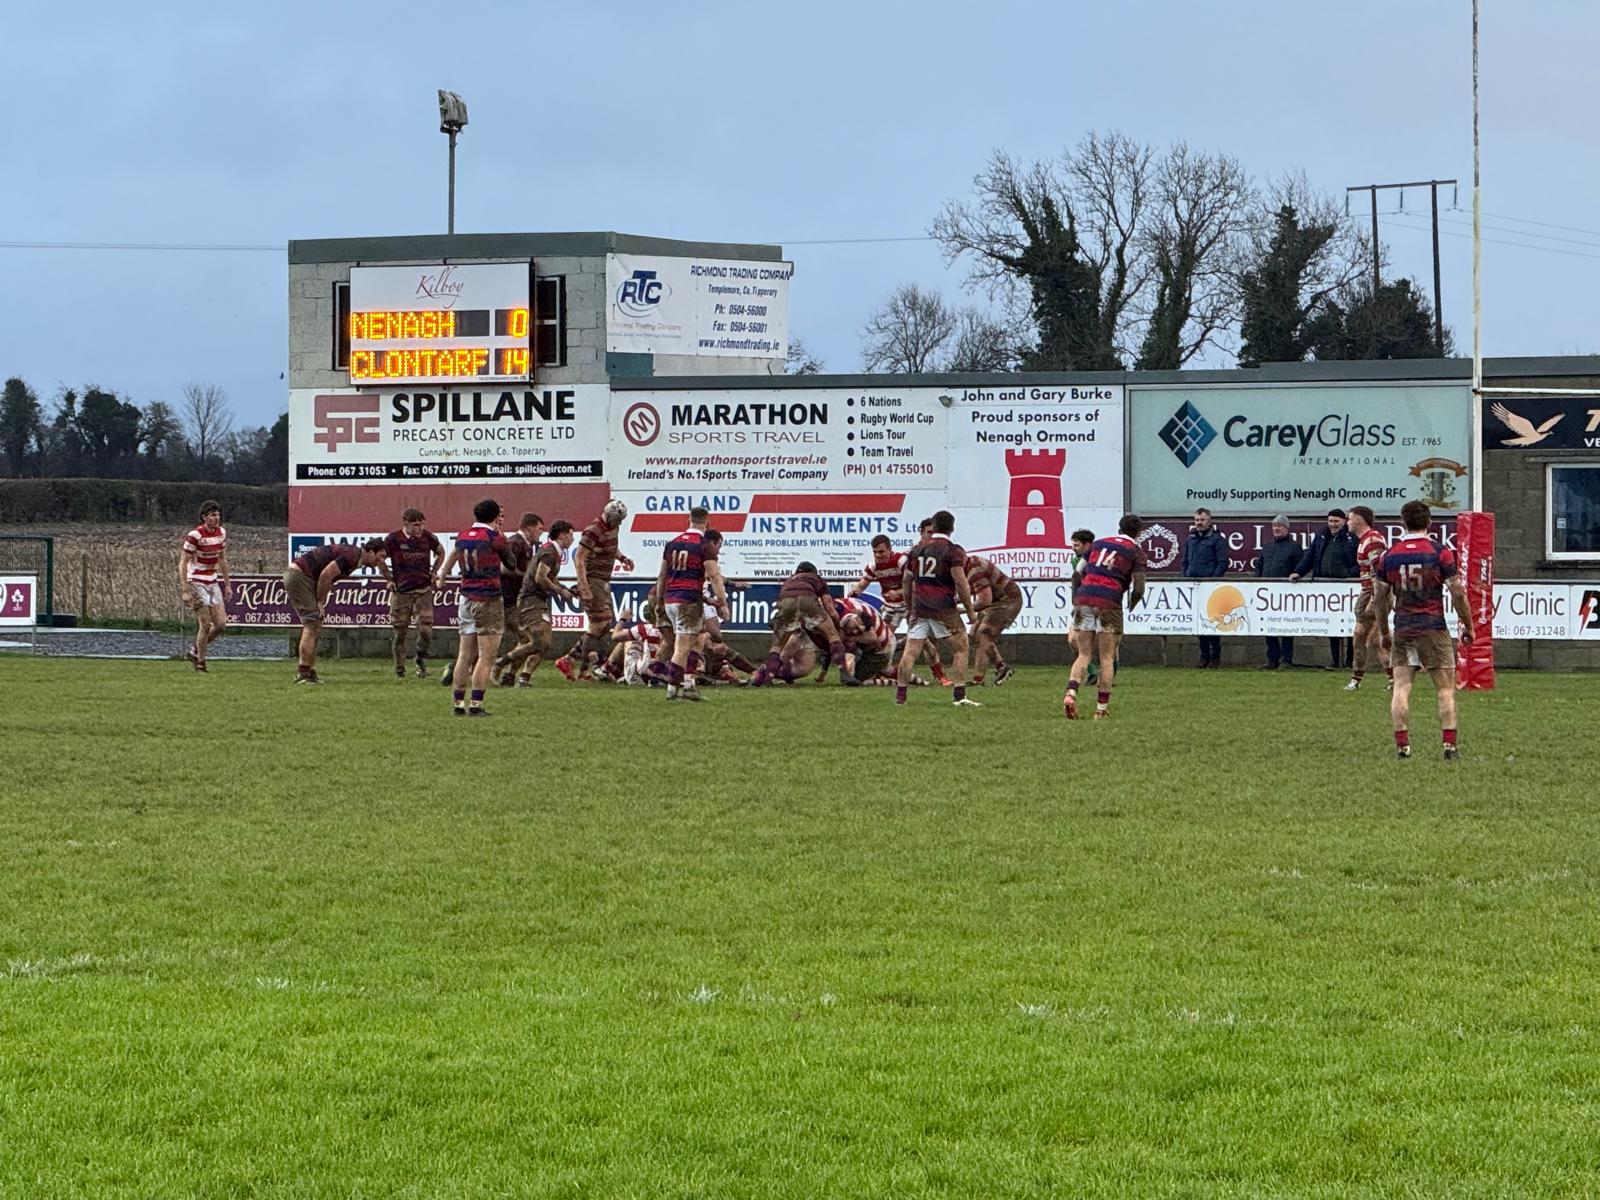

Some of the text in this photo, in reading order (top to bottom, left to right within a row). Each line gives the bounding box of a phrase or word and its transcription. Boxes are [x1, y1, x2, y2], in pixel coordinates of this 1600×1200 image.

[690, 265, 791, 281] RICHMOND TRADING COMPAN
[416, 267, 464, 309] Kilboy
[621, 270, 662, 304] RTC
[714, 304, 767, 317] Ph: 0504-56000
[352, 309, 529, 340] NENAGH 0
[712, 320, 768, 333] Fax: 0504-56001
[699, 337, 780, 352] www.richmondtrading.ie
[351, 349, 529, 379] CLONTARF 14
[860, 396, 902, 407] 6 Nations
[961, 387, 1112, 403] John and Gary Burke
[391, 390, 576, 423] SPILLANE
[671, 403, 828, 426] MARATHON
[860, 412, 934, 426] Rugby World Cup
[971, 409, 1100, 425] Proud sponsors of
[393, 426, 575, 442] PRECAST CONCRETE LTD
[668, 431, 825, 444] SPORTS TRAVEL
[860, 429, 906, 440] Lions Tour
[976, 429, 1095, 446] Nenagh Ormond
[1223, 413, 1442, 456] CareyGlass EST. 1965
[511, 446, 547, 457] Tipperary
[860, 446, 914, 457] Team Travel
[645, 453, 827, 468] www.marathonsportstravel.ie
[1293, 457, 1396, 465] INTERNATIONAL
[308, 463, 592, 476] Phone: 067 31053 Fax: 067 41709 Email: spillci@eircom.net
[741, 468, 774, 480] Travel
[778, 468, 829, 481] Company
[843, 463, 933, 477] (PH) 01 4755010
[1186, 487, 1407, 501] Proudly Supporting Nenagh Ormond RFC
[645, 495, 741, 512] GARLAND
[751, 517, 899, 533] INSTRUMENTS
[765, 539, 808, 547] PROBLEMS
[810, 539, 830, 547] WITH
[832, 539, 851, 547] NEW
[989, 551, 1046, 566] ORMOND
[1095, 548, 1118, 571] 14
[917, 556, 937, 578] 12
[1011, 566, 1061, 579] PTY LTD
[1400, 564, 1422, 591] 15
[1256, 587, 1360, 612] Summerh
[1510, 592, 1565, 616] Clinic
[245, 612, 262, 623] 067
[264, 612, 291, 623] 31395
[1127, 613, 1151, 623] 067
[1154, 613, 1193, 623] 56705
[1495, 625, 1510, 636] Tel:
[1513, 625, 1566, 636] 067-31248
